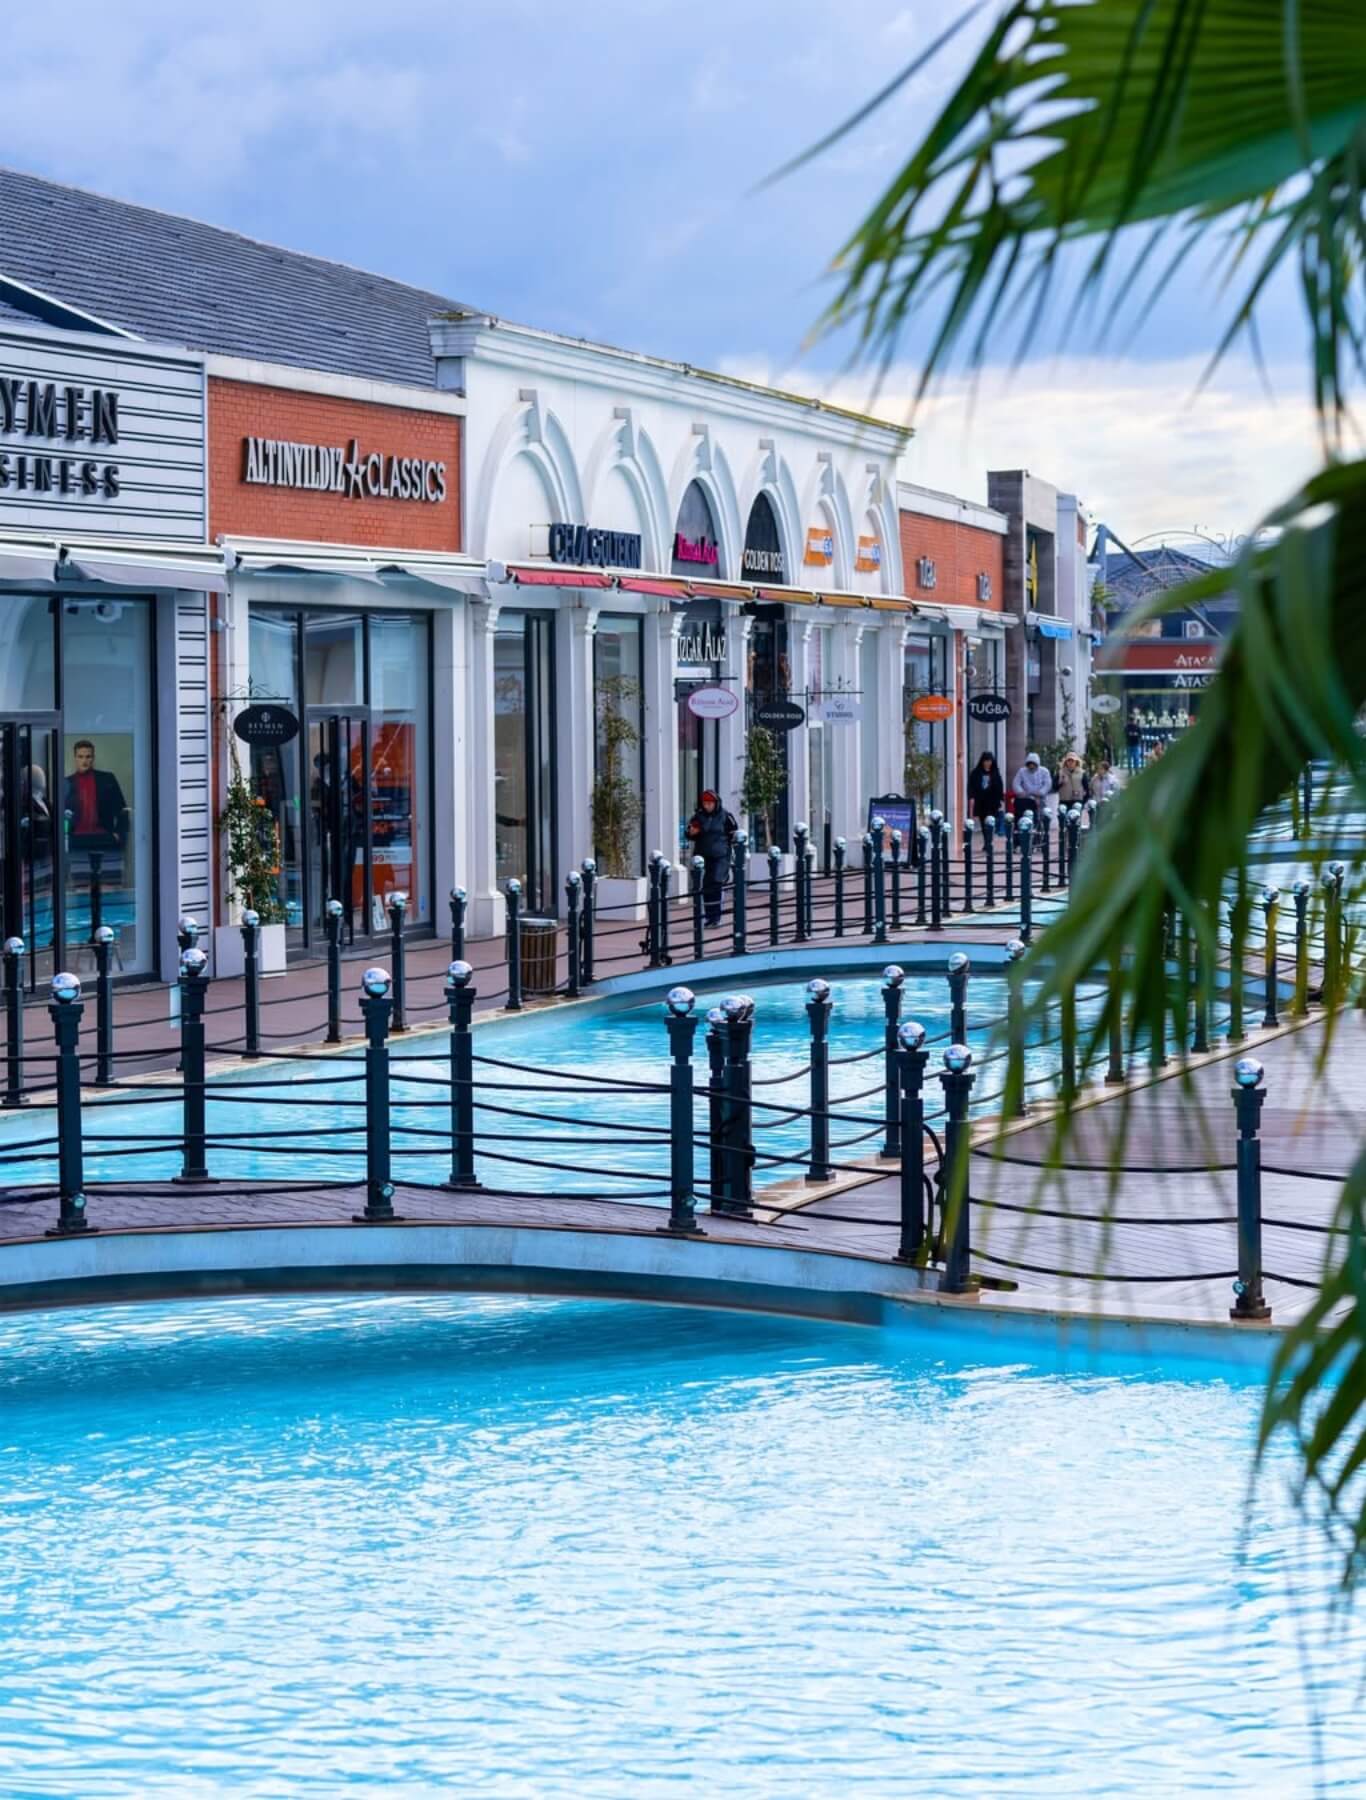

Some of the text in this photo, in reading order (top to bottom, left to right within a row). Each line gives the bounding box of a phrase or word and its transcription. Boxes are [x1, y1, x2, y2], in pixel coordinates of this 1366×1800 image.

[243, 436, 447, 503] ALTINYILDIZ CLASSICS
[744, 548, 768, 571] GOLDEN
[704, 621, 726, 662] ALAZ
[969, 701, 1010, 715] TUĞBA
